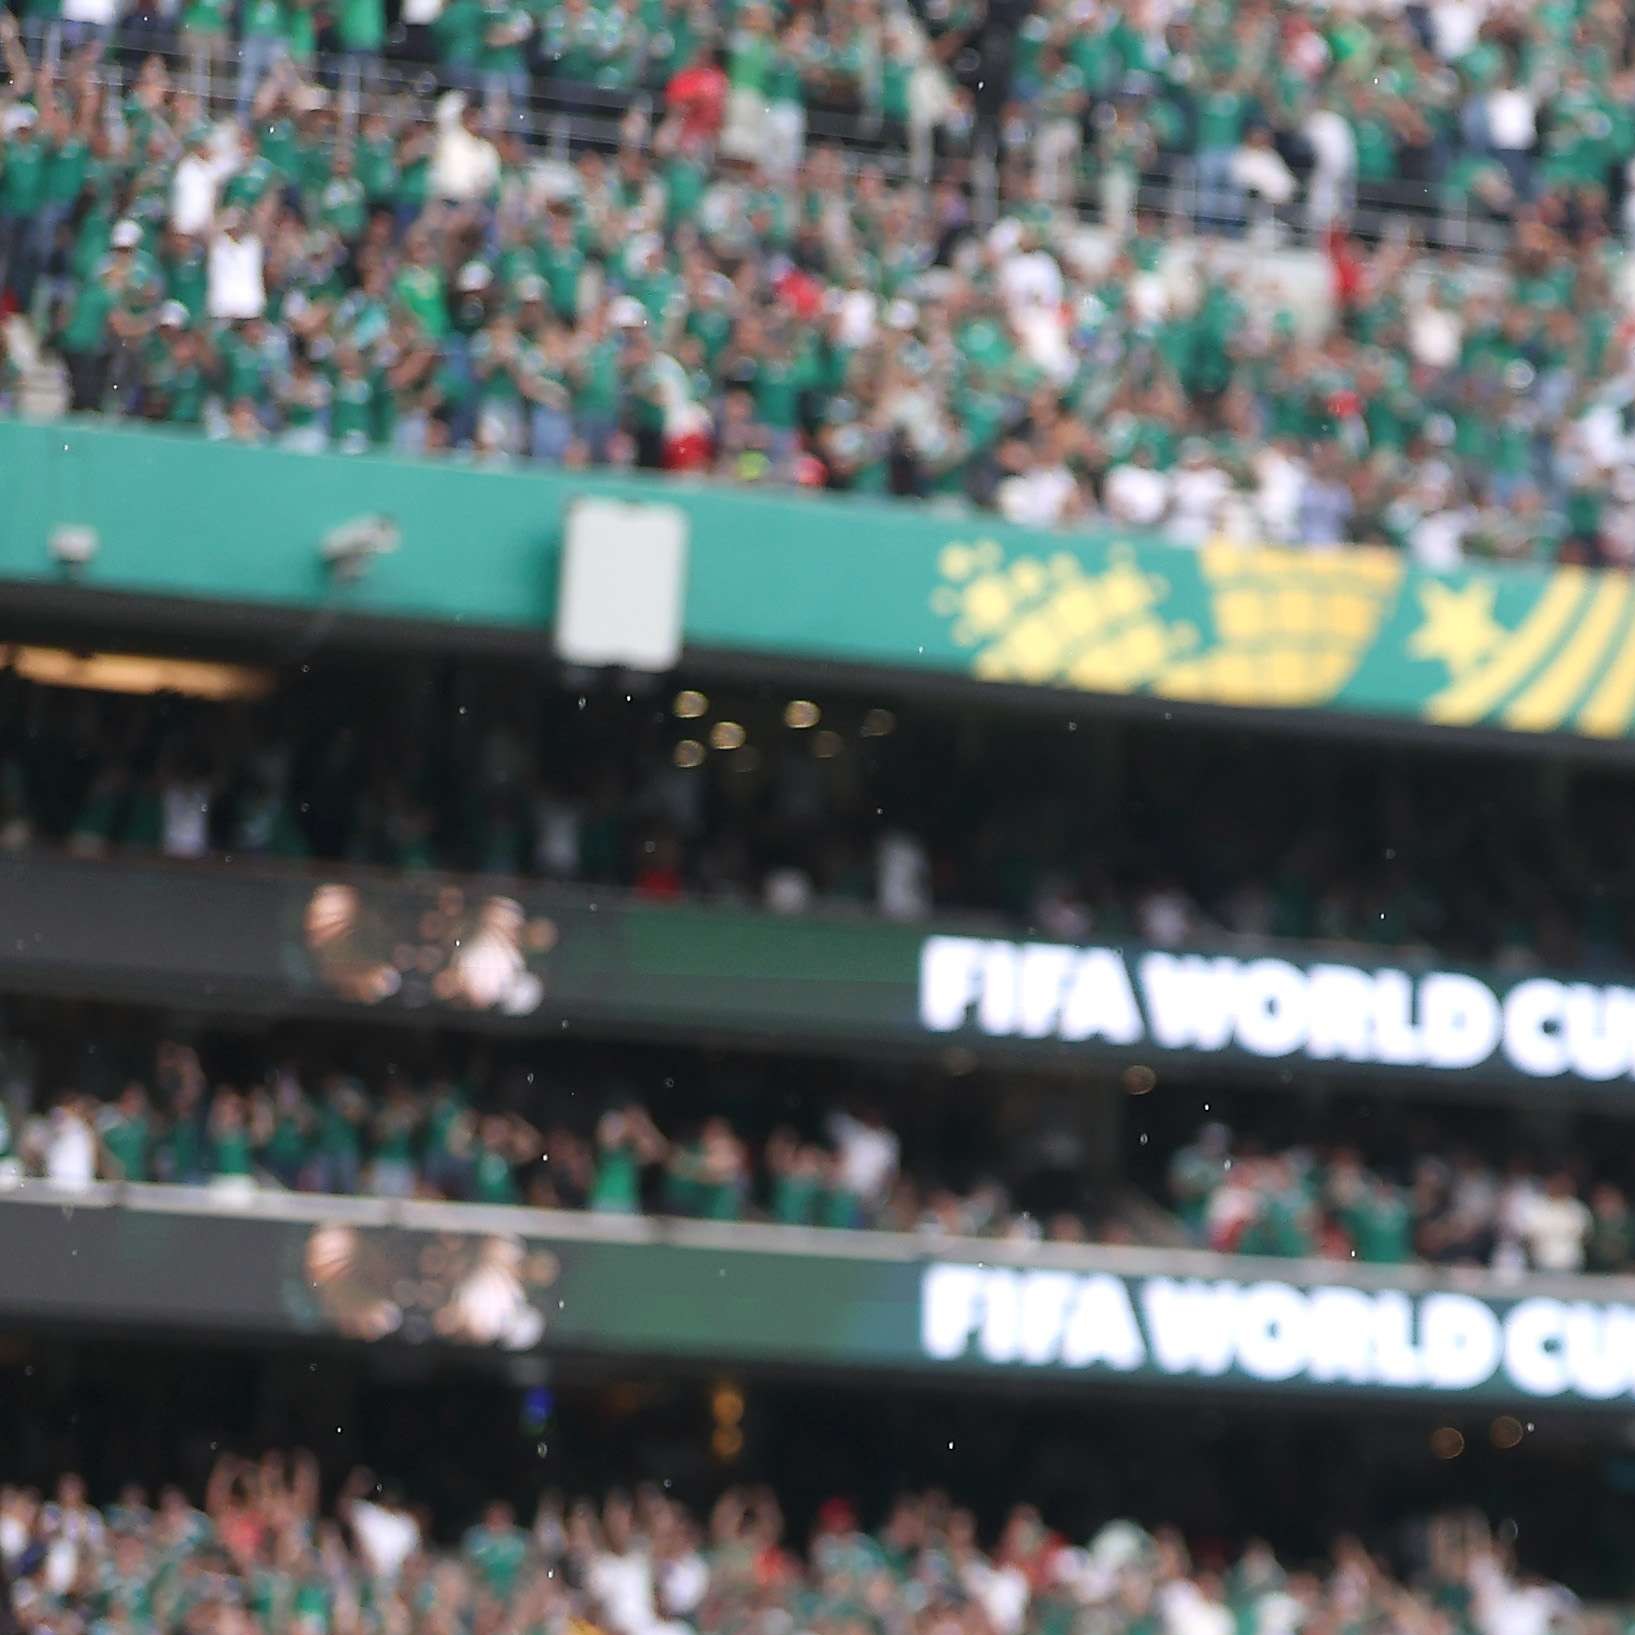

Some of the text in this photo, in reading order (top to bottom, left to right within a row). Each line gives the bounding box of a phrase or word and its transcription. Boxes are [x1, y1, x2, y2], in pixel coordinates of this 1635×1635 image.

[922, 936, 1141, 1043] FIFA
[1142, 954, 1503, 1068] WORLD
[922, 1262, 1141, 1370] FIFA
[1143, 1276, 1503, 1389] WORLD
